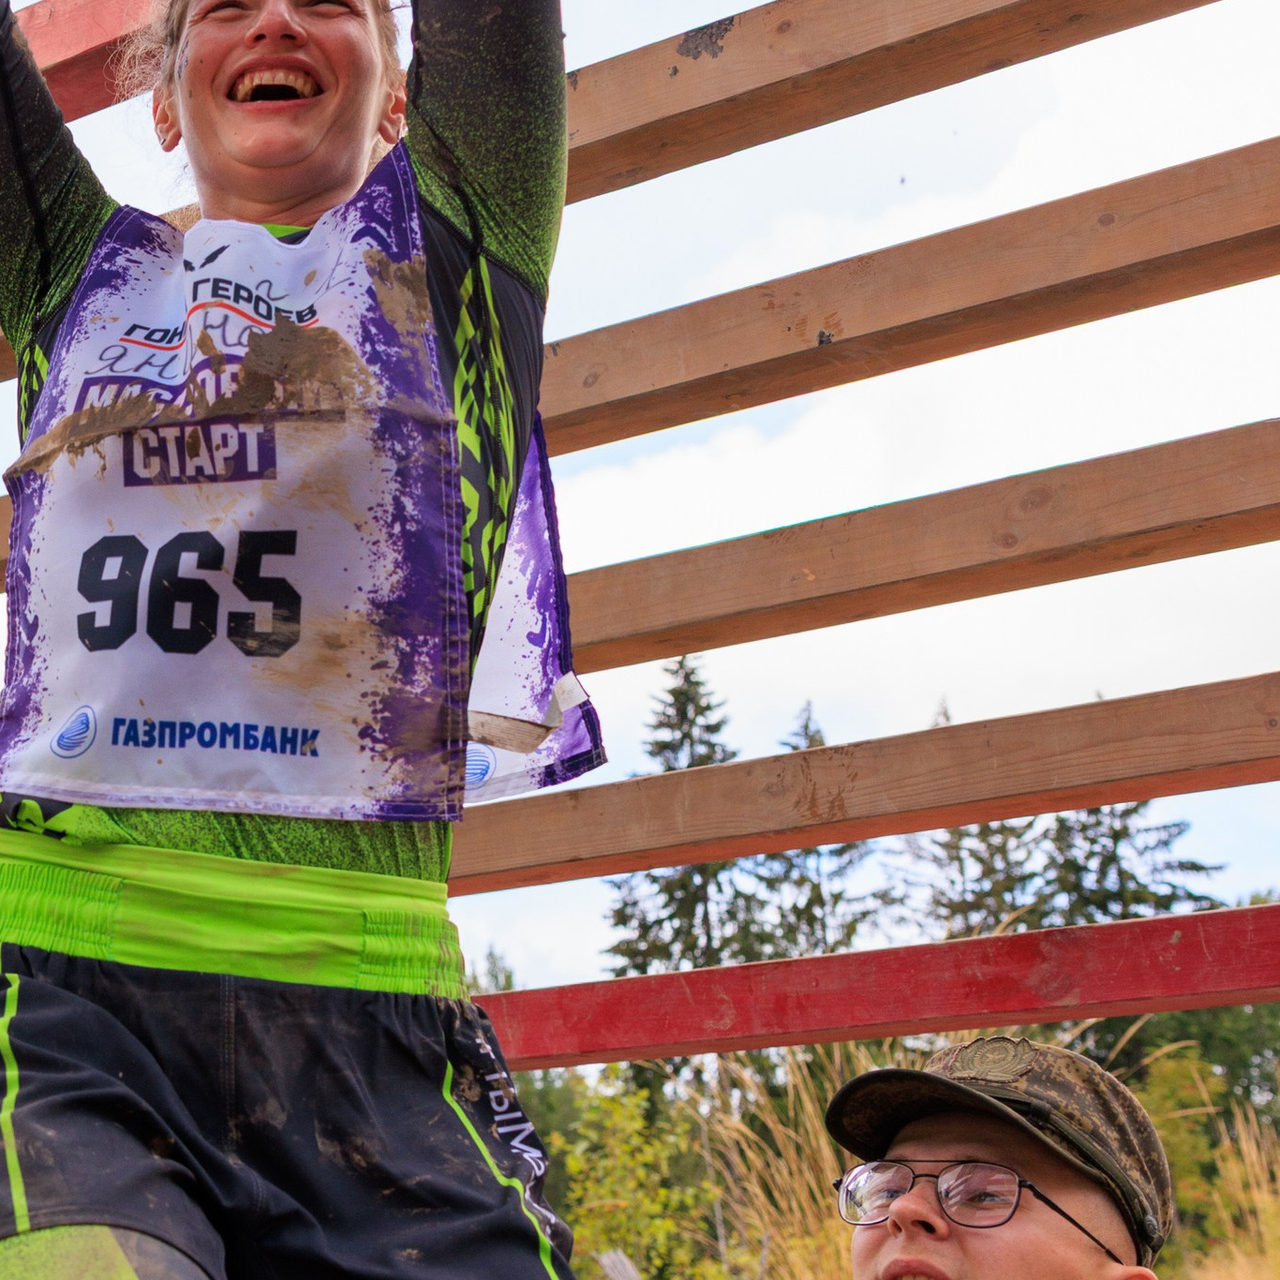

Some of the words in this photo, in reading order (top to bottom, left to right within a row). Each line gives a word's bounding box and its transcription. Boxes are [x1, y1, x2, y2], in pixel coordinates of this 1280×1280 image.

[132, 423, 264, 479] СТАРТ
[77, 529, 302, 658] 965
[111, 717, 321, 757] ГАЗПРОМБАНК
